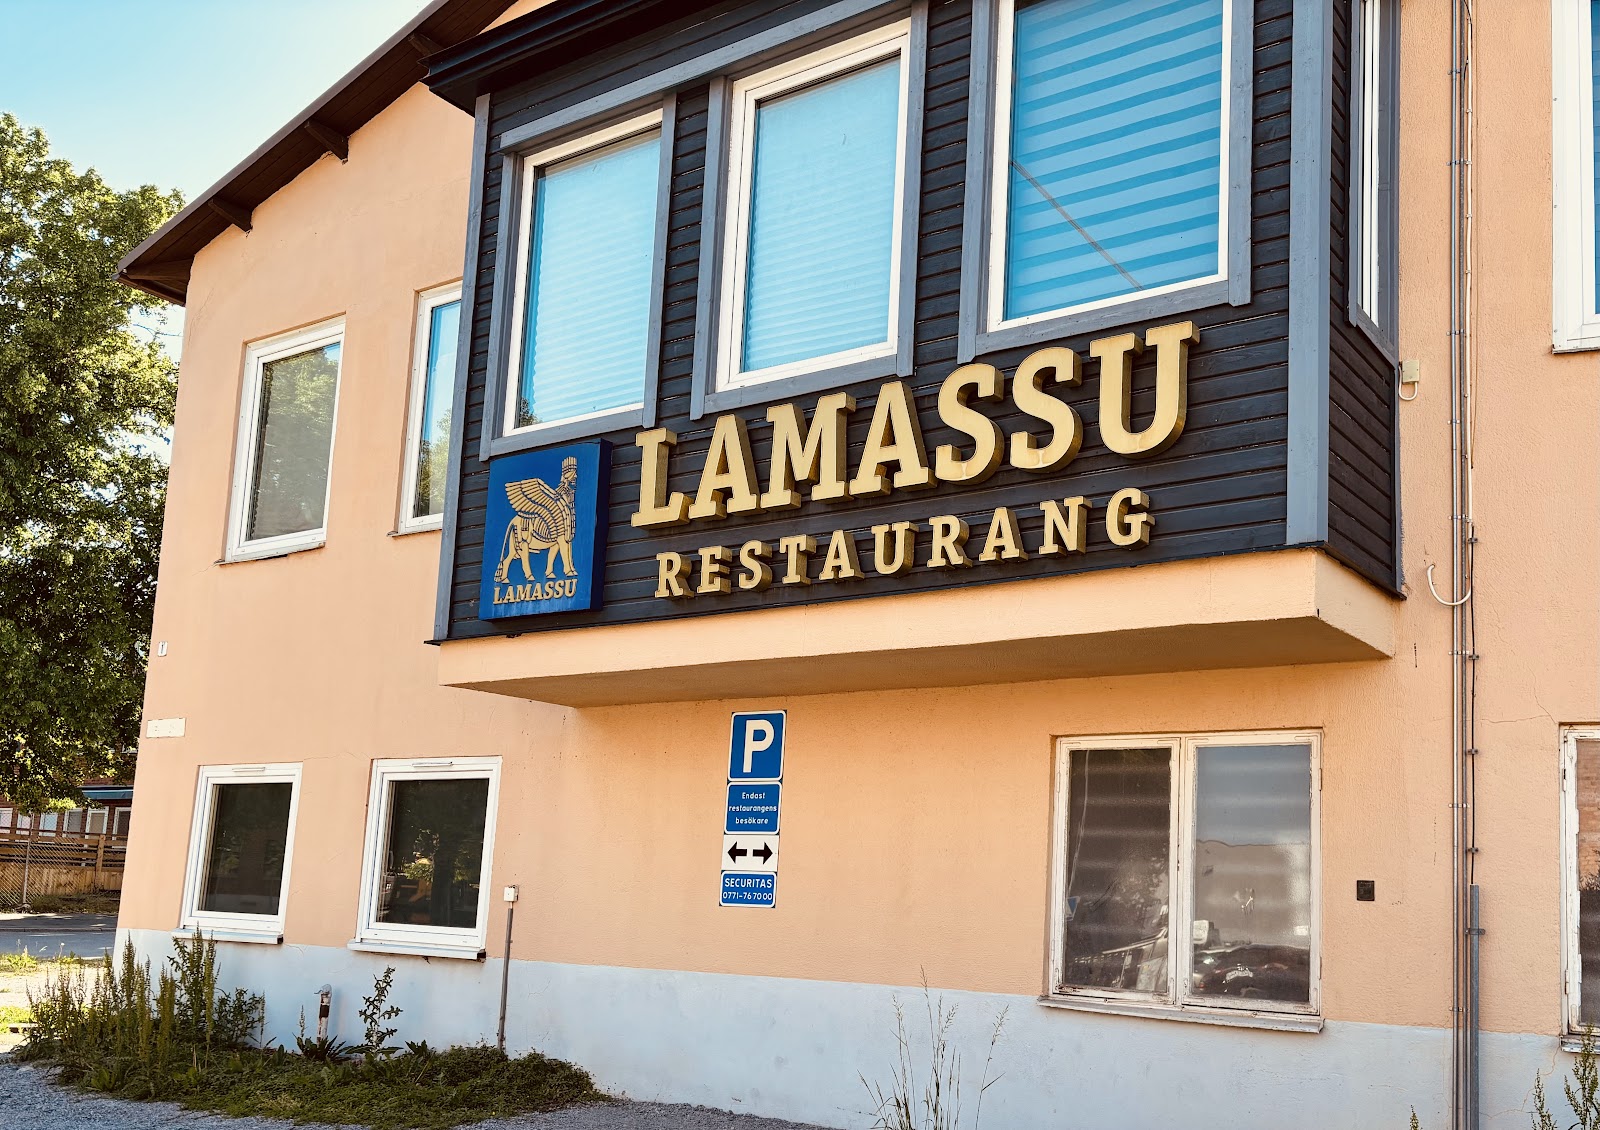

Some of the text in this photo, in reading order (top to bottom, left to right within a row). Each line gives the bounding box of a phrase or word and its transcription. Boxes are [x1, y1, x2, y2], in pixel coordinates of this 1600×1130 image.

[630, 320, 1200, 530] LAMASSU
[654, 487, 1155, 599] RESTAURANG
[493, 578, 579, 605] LAMASSU
[743, 719, 775, 773] P
[741, 791, 766, 800] Endast
[728, 805, 778, 813] restaurangens
[735, 816, 769, 825] besökare
[724, 878, 773, 888] SECURITAS
